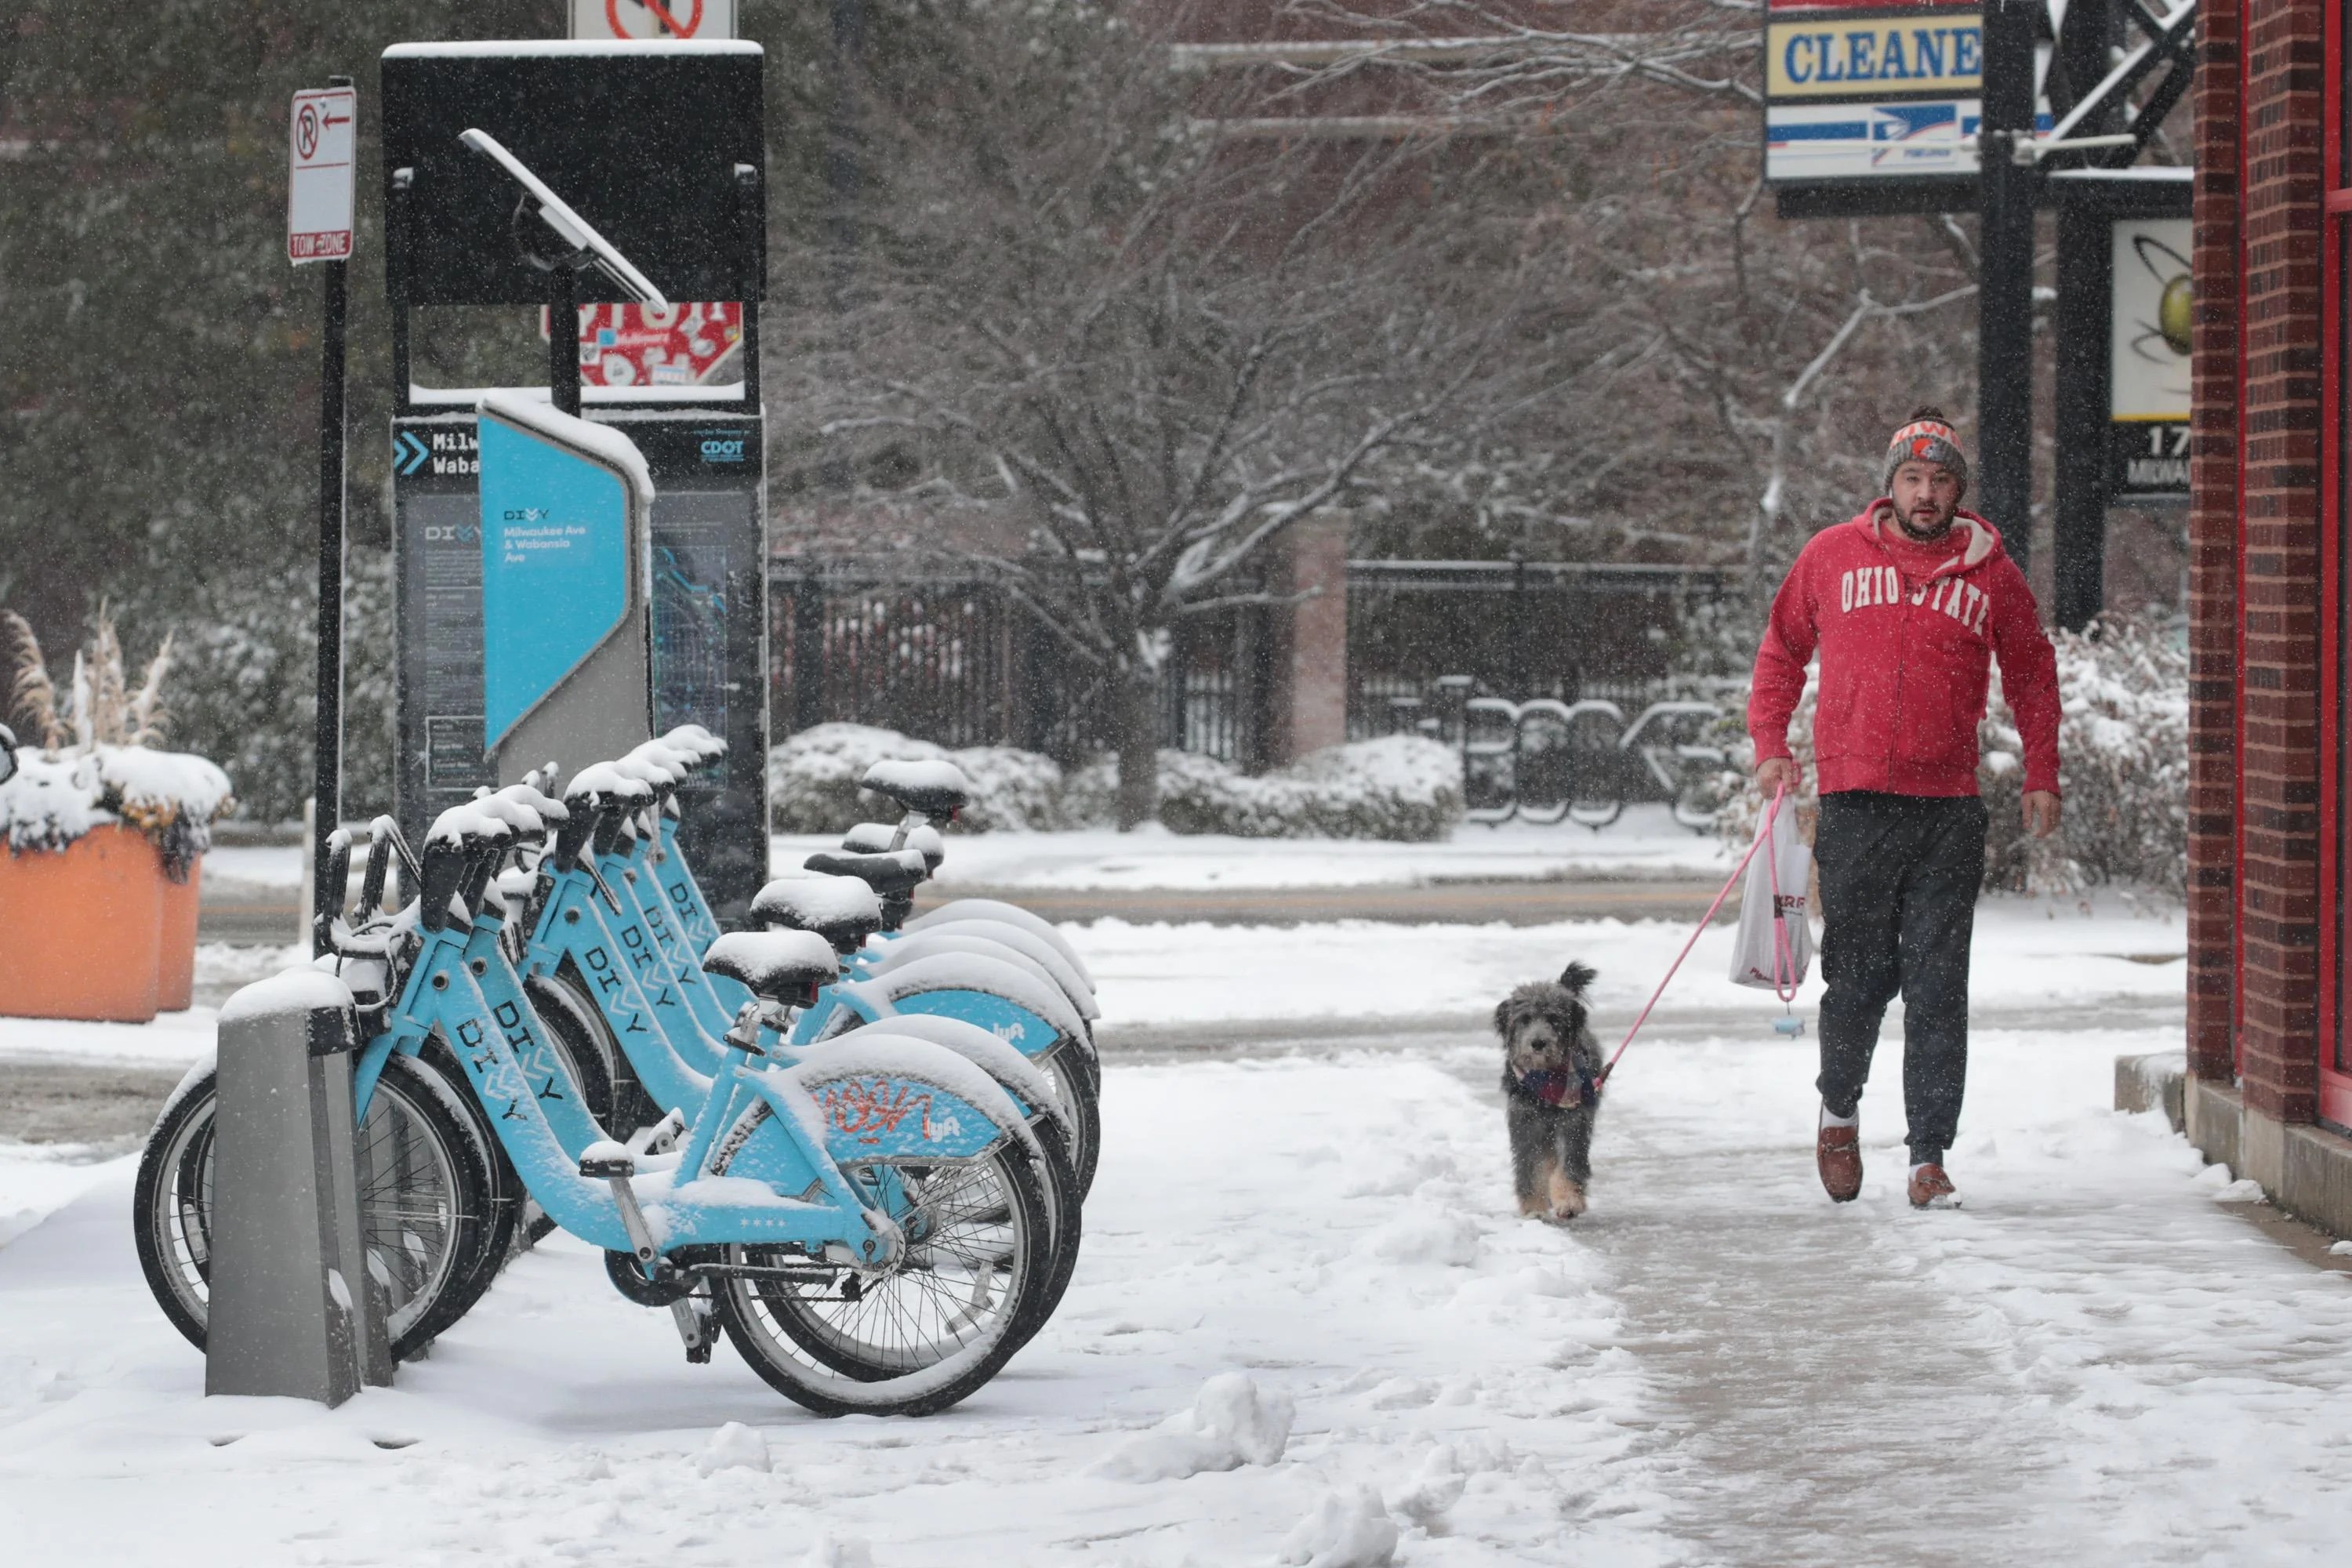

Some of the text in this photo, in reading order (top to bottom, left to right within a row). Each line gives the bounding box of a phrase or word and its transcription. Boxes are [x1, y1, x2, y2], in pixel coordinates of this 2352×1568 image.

[1784, 27, 1982, 84] CLEANE
[292, 235, 314, 256] TOW
[701, 440, 744, 454] CDOT
[433, 457, 480, 474] Waba
[504, 525, 586, 538] Milwaukee Ave
[504, 538, 571, 550] & Wabansia
[505, 552, 525, 563] Ave
[1842, 566, 1899, 613] OHIO
[993, 1022, 1025, 1043] lyft
[927, 1116, 960, 1142] lyft
